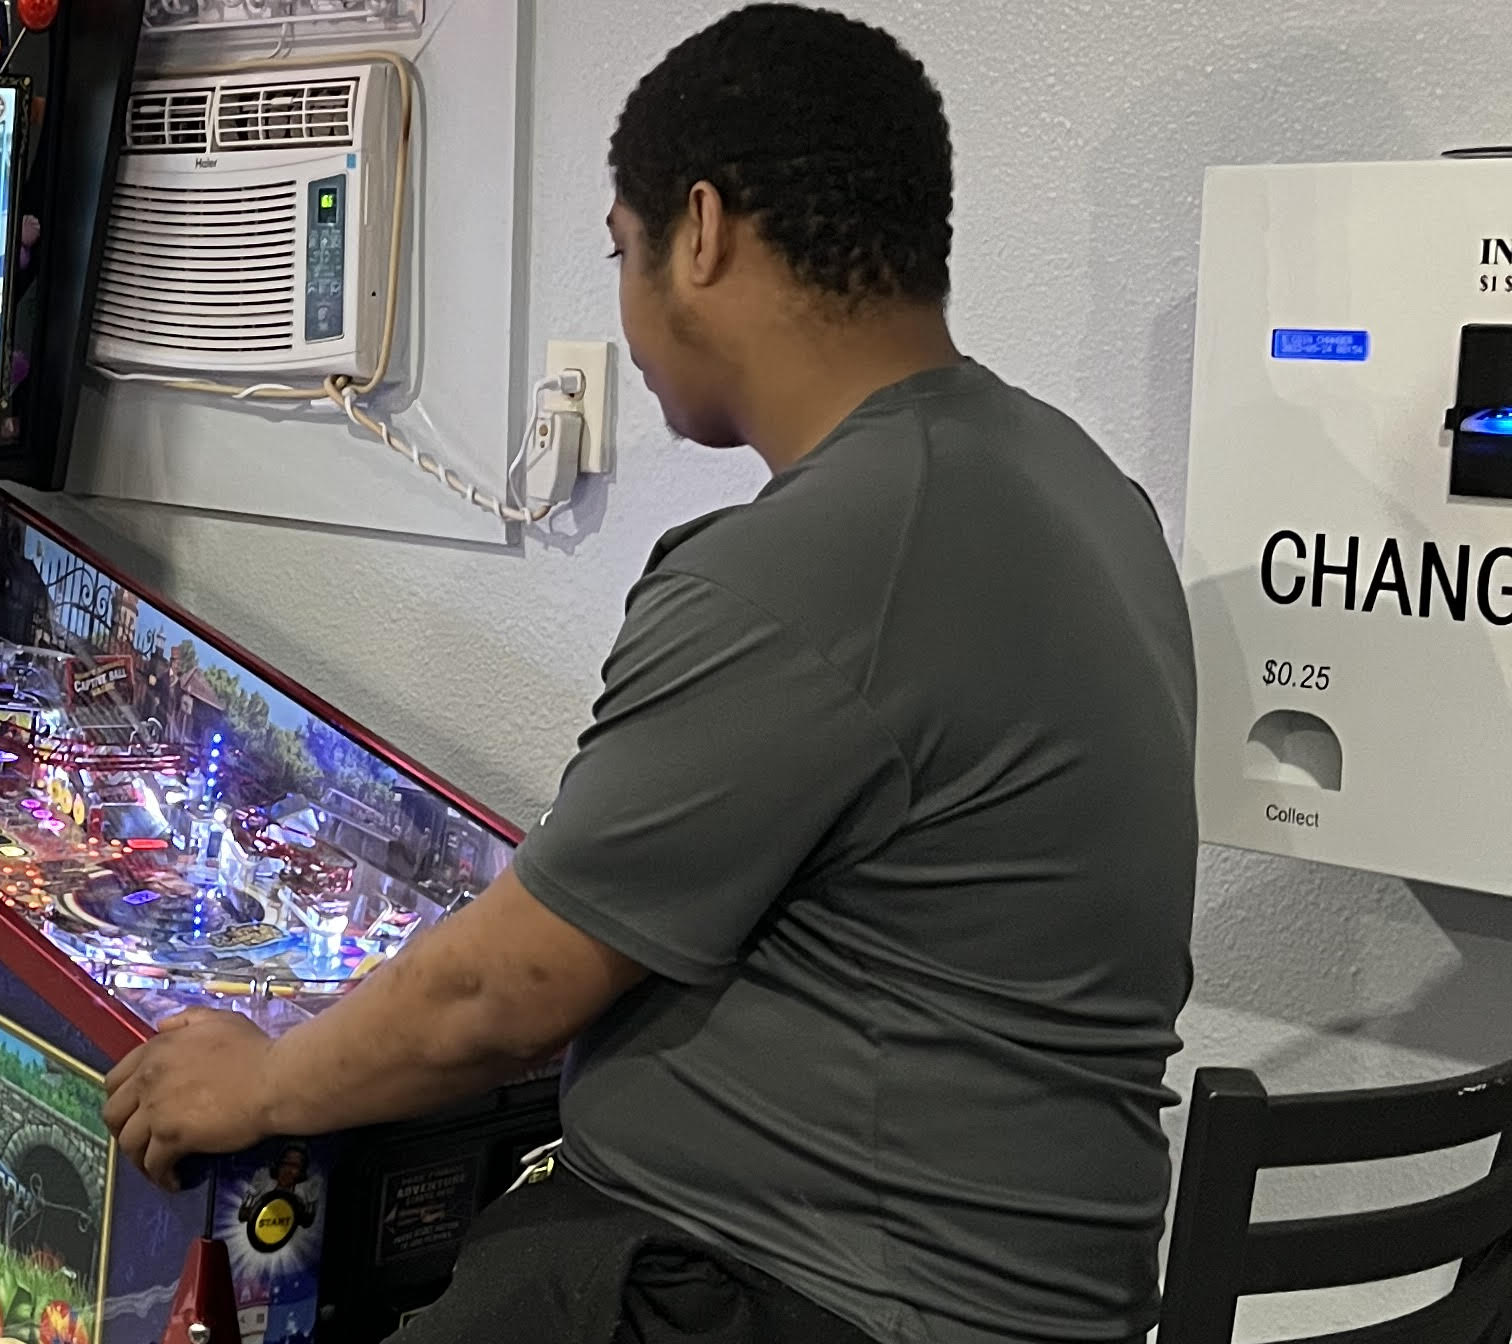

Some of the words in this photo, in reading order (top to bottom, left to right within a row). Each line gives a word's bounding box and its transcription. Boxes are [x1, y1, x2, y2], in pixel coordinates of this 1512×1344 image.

[1260, 529, 1512, 626] CHANG
[1262, 658, 1331, 690] $0.25
[1265, 803, 1319, 828] Collect
[257, 1215, 292, 1230] START
